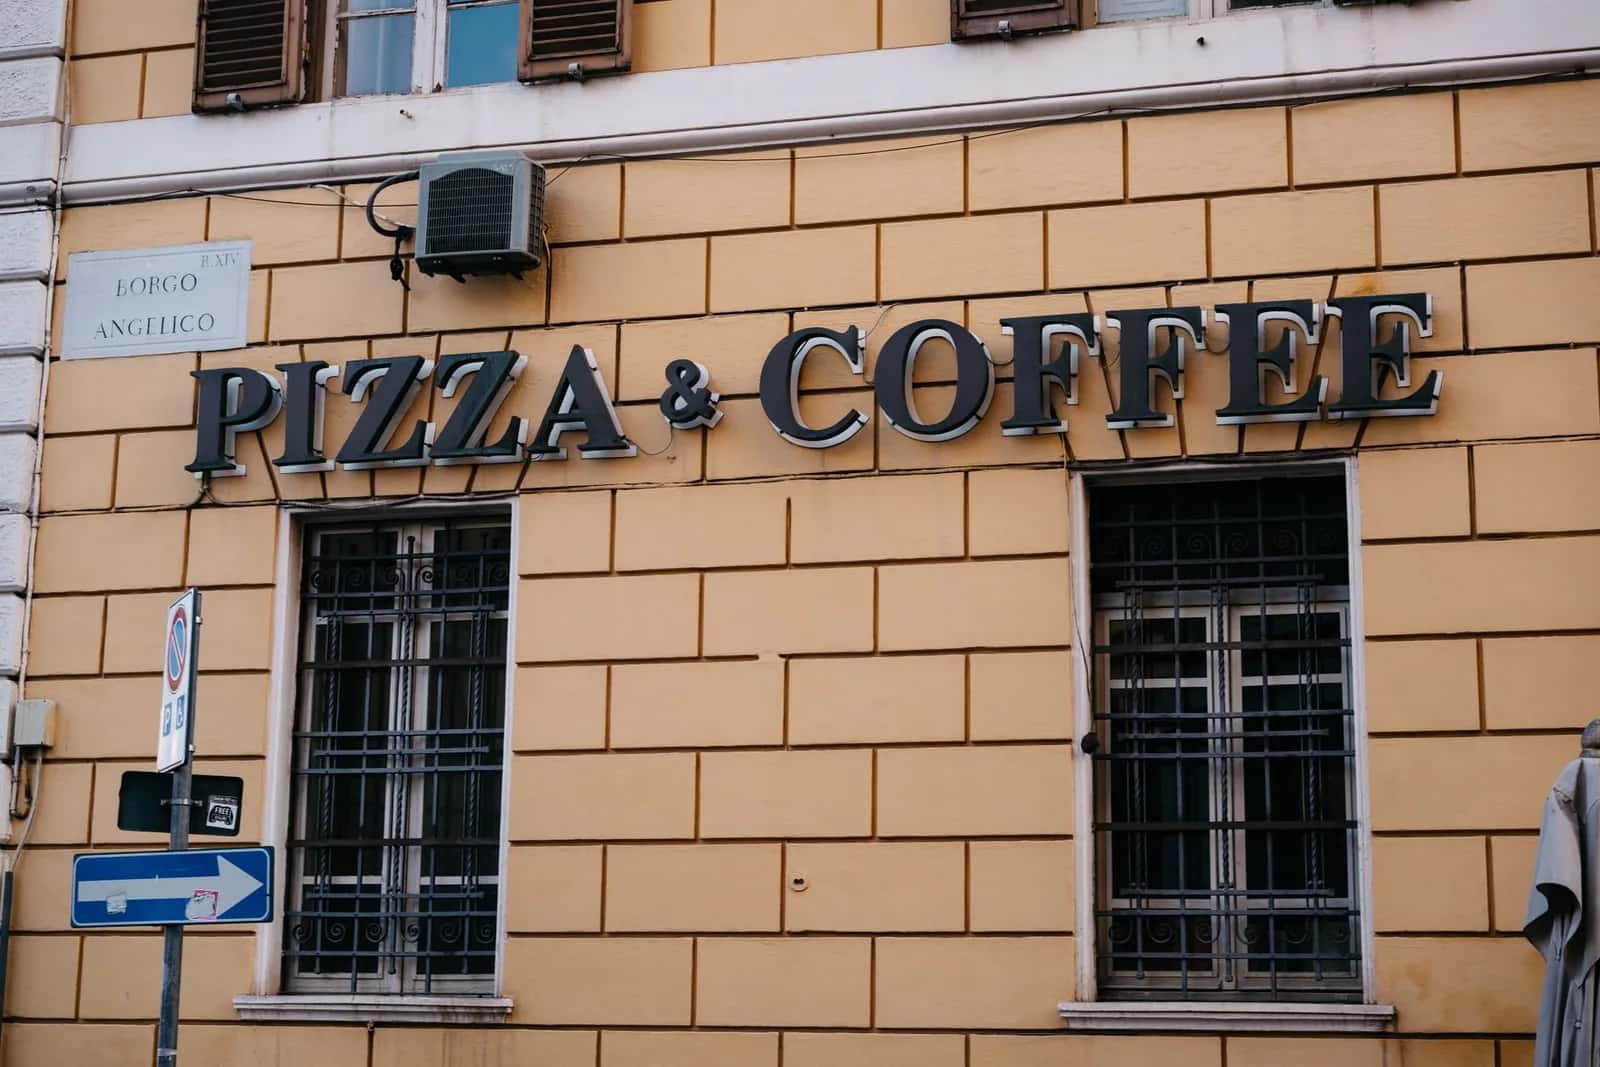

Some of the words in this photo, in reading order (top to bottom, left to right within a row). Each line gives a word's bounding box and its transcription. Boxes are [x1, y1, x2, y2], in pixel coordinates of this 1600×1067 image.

[116, 273, 198, 297] BORGO
[94, 313, 215, 340] ANGELICO
[185, 344, 637, 478] PIZZA
[660, 359, 724, 431] &
[760, 293, 1441, 449] COFFEE
